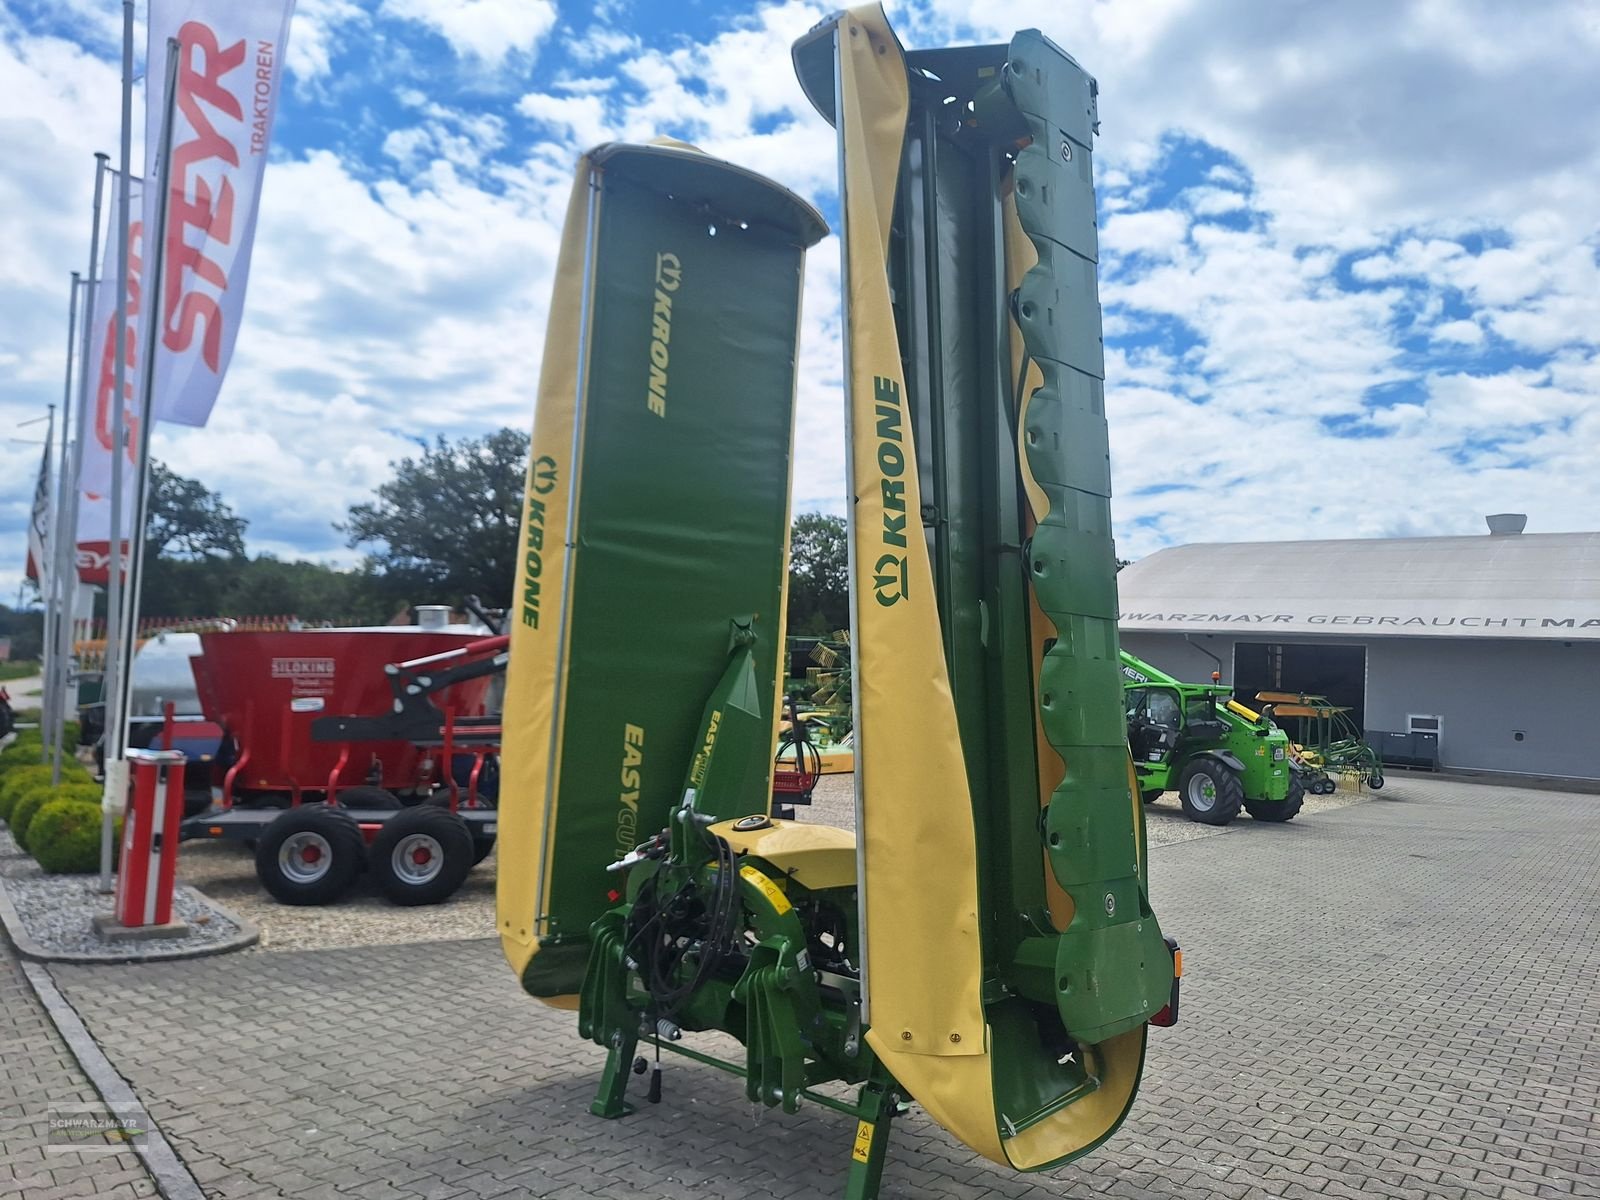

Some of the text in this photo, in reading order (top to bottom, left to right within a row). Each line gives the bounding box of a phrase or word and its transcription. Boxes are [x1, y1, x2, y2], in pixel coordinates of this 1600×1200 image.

[249, 40, 273, 155] TRAKTOREN
[163, 20, 247, 374] STEYR
[647, 288, 672, 419] KRONE
[874, 375, 907, 549] KRONE
[522, 498, 546, 630] KRONE
